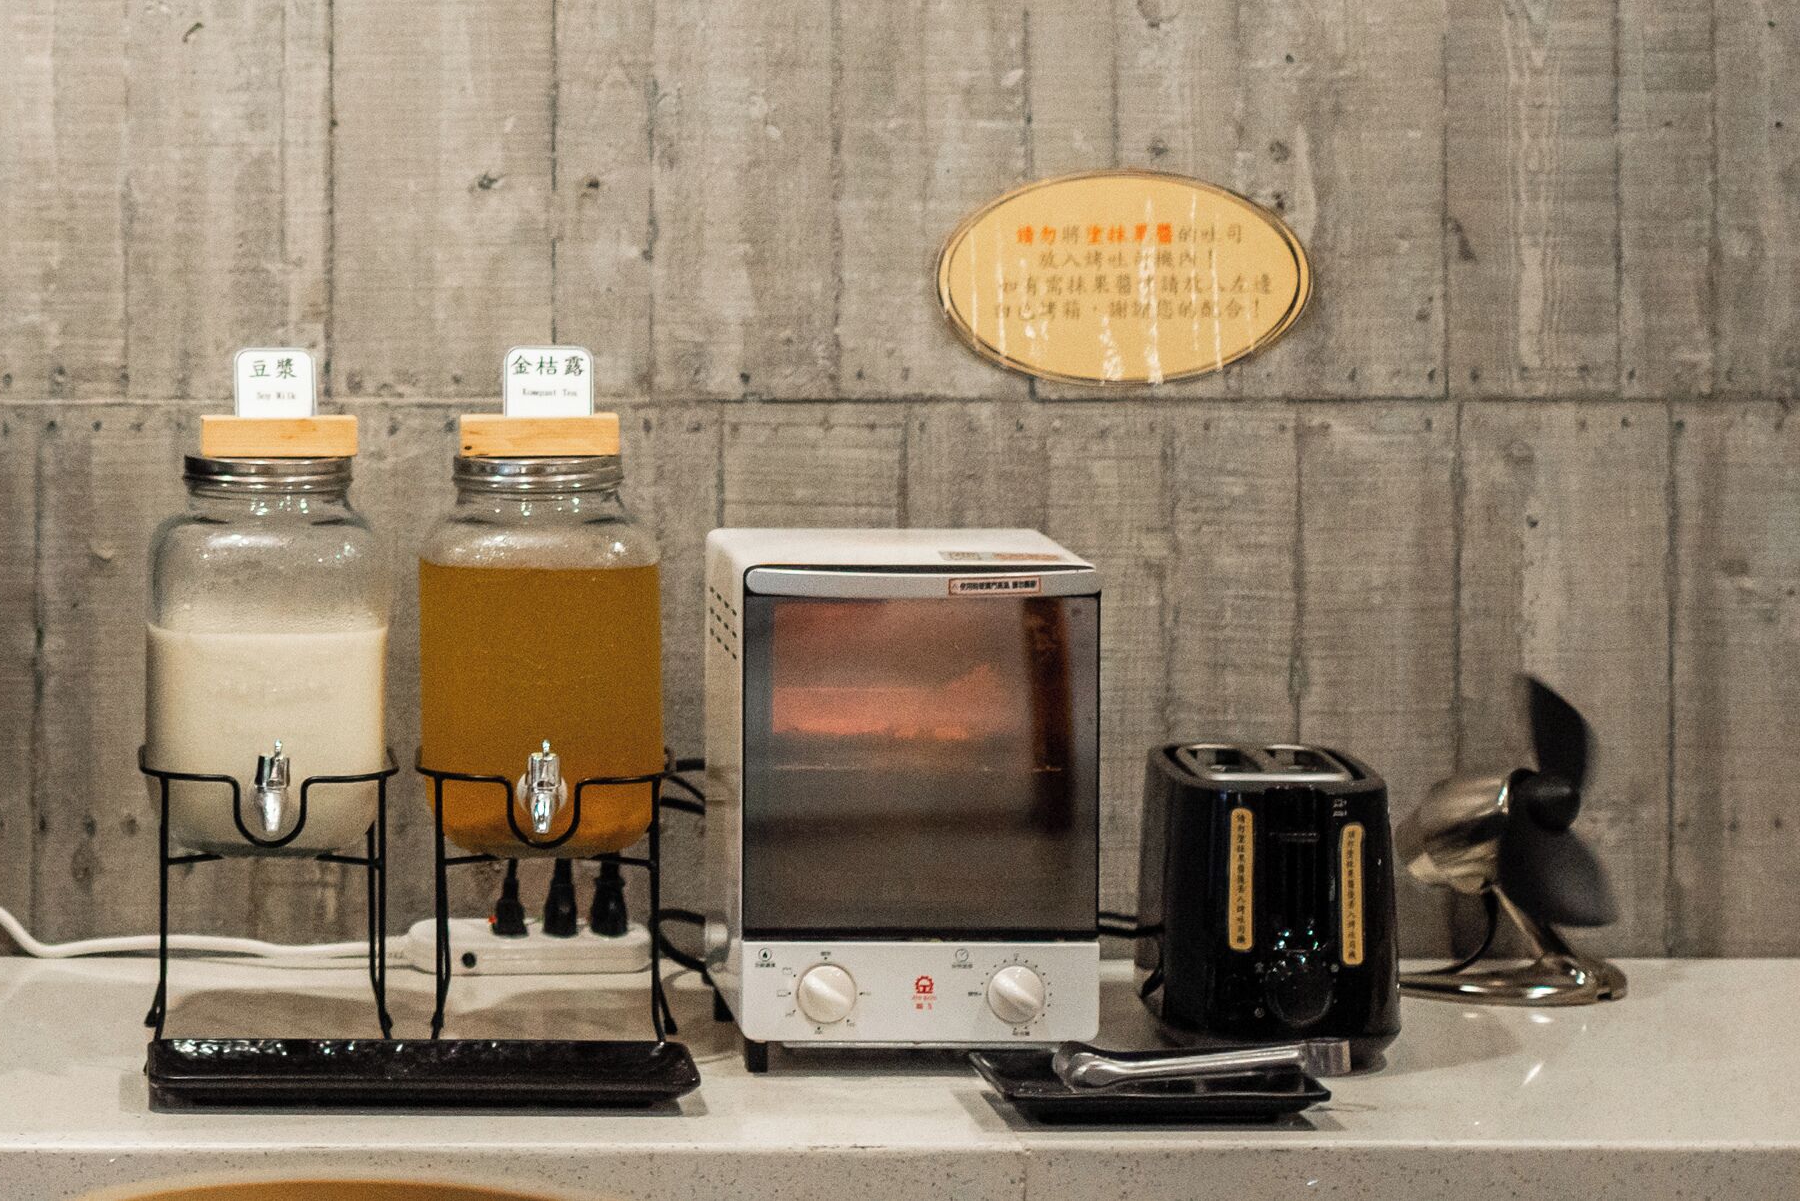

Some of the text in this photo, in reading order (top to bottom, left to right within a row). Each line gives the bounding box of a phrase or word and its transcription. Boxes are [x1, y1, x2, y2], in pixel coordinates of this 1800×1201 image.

[248, 358, 297, 379] 豆漿
[511, 355, 584, 376] 金桔露
